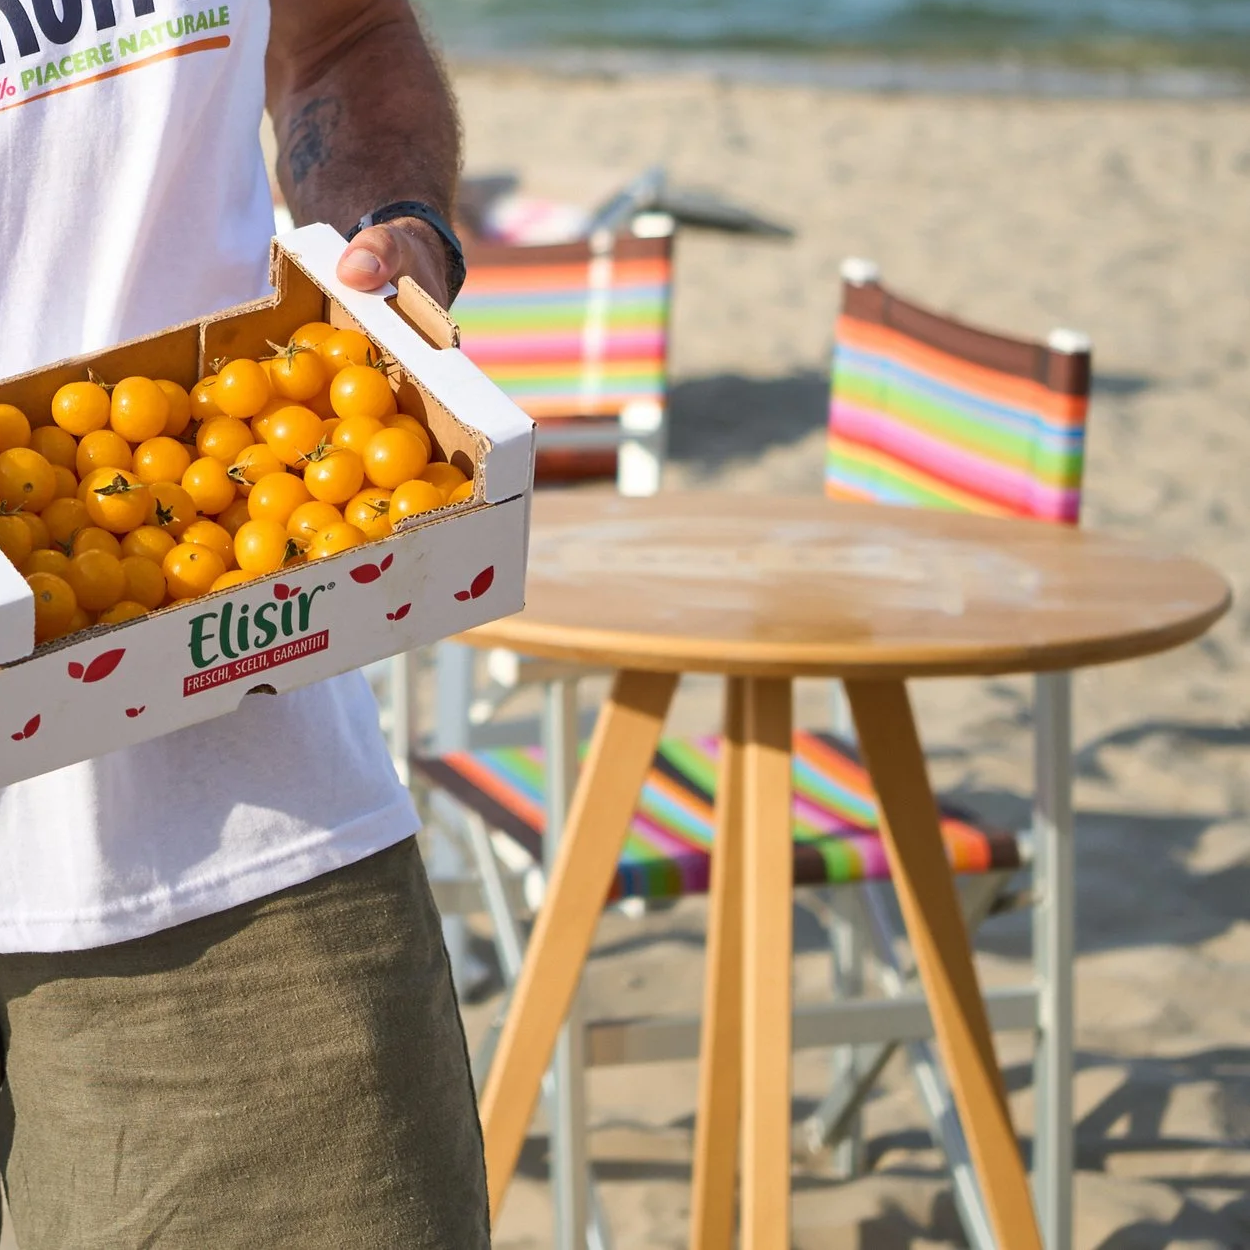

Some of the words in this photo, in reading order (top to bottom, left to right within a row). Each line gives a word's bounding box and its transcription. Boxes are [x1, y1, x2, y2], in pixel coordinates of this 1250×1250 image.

[20, 38, 114, 91] PIACERE
[117, 5, 231, 58] NATURALE
[186, 667, 232, 692] FRESCHI,
[235, 654, 270, 676] SCELTI,
[273, 634, 326, 662] GARANTITI
